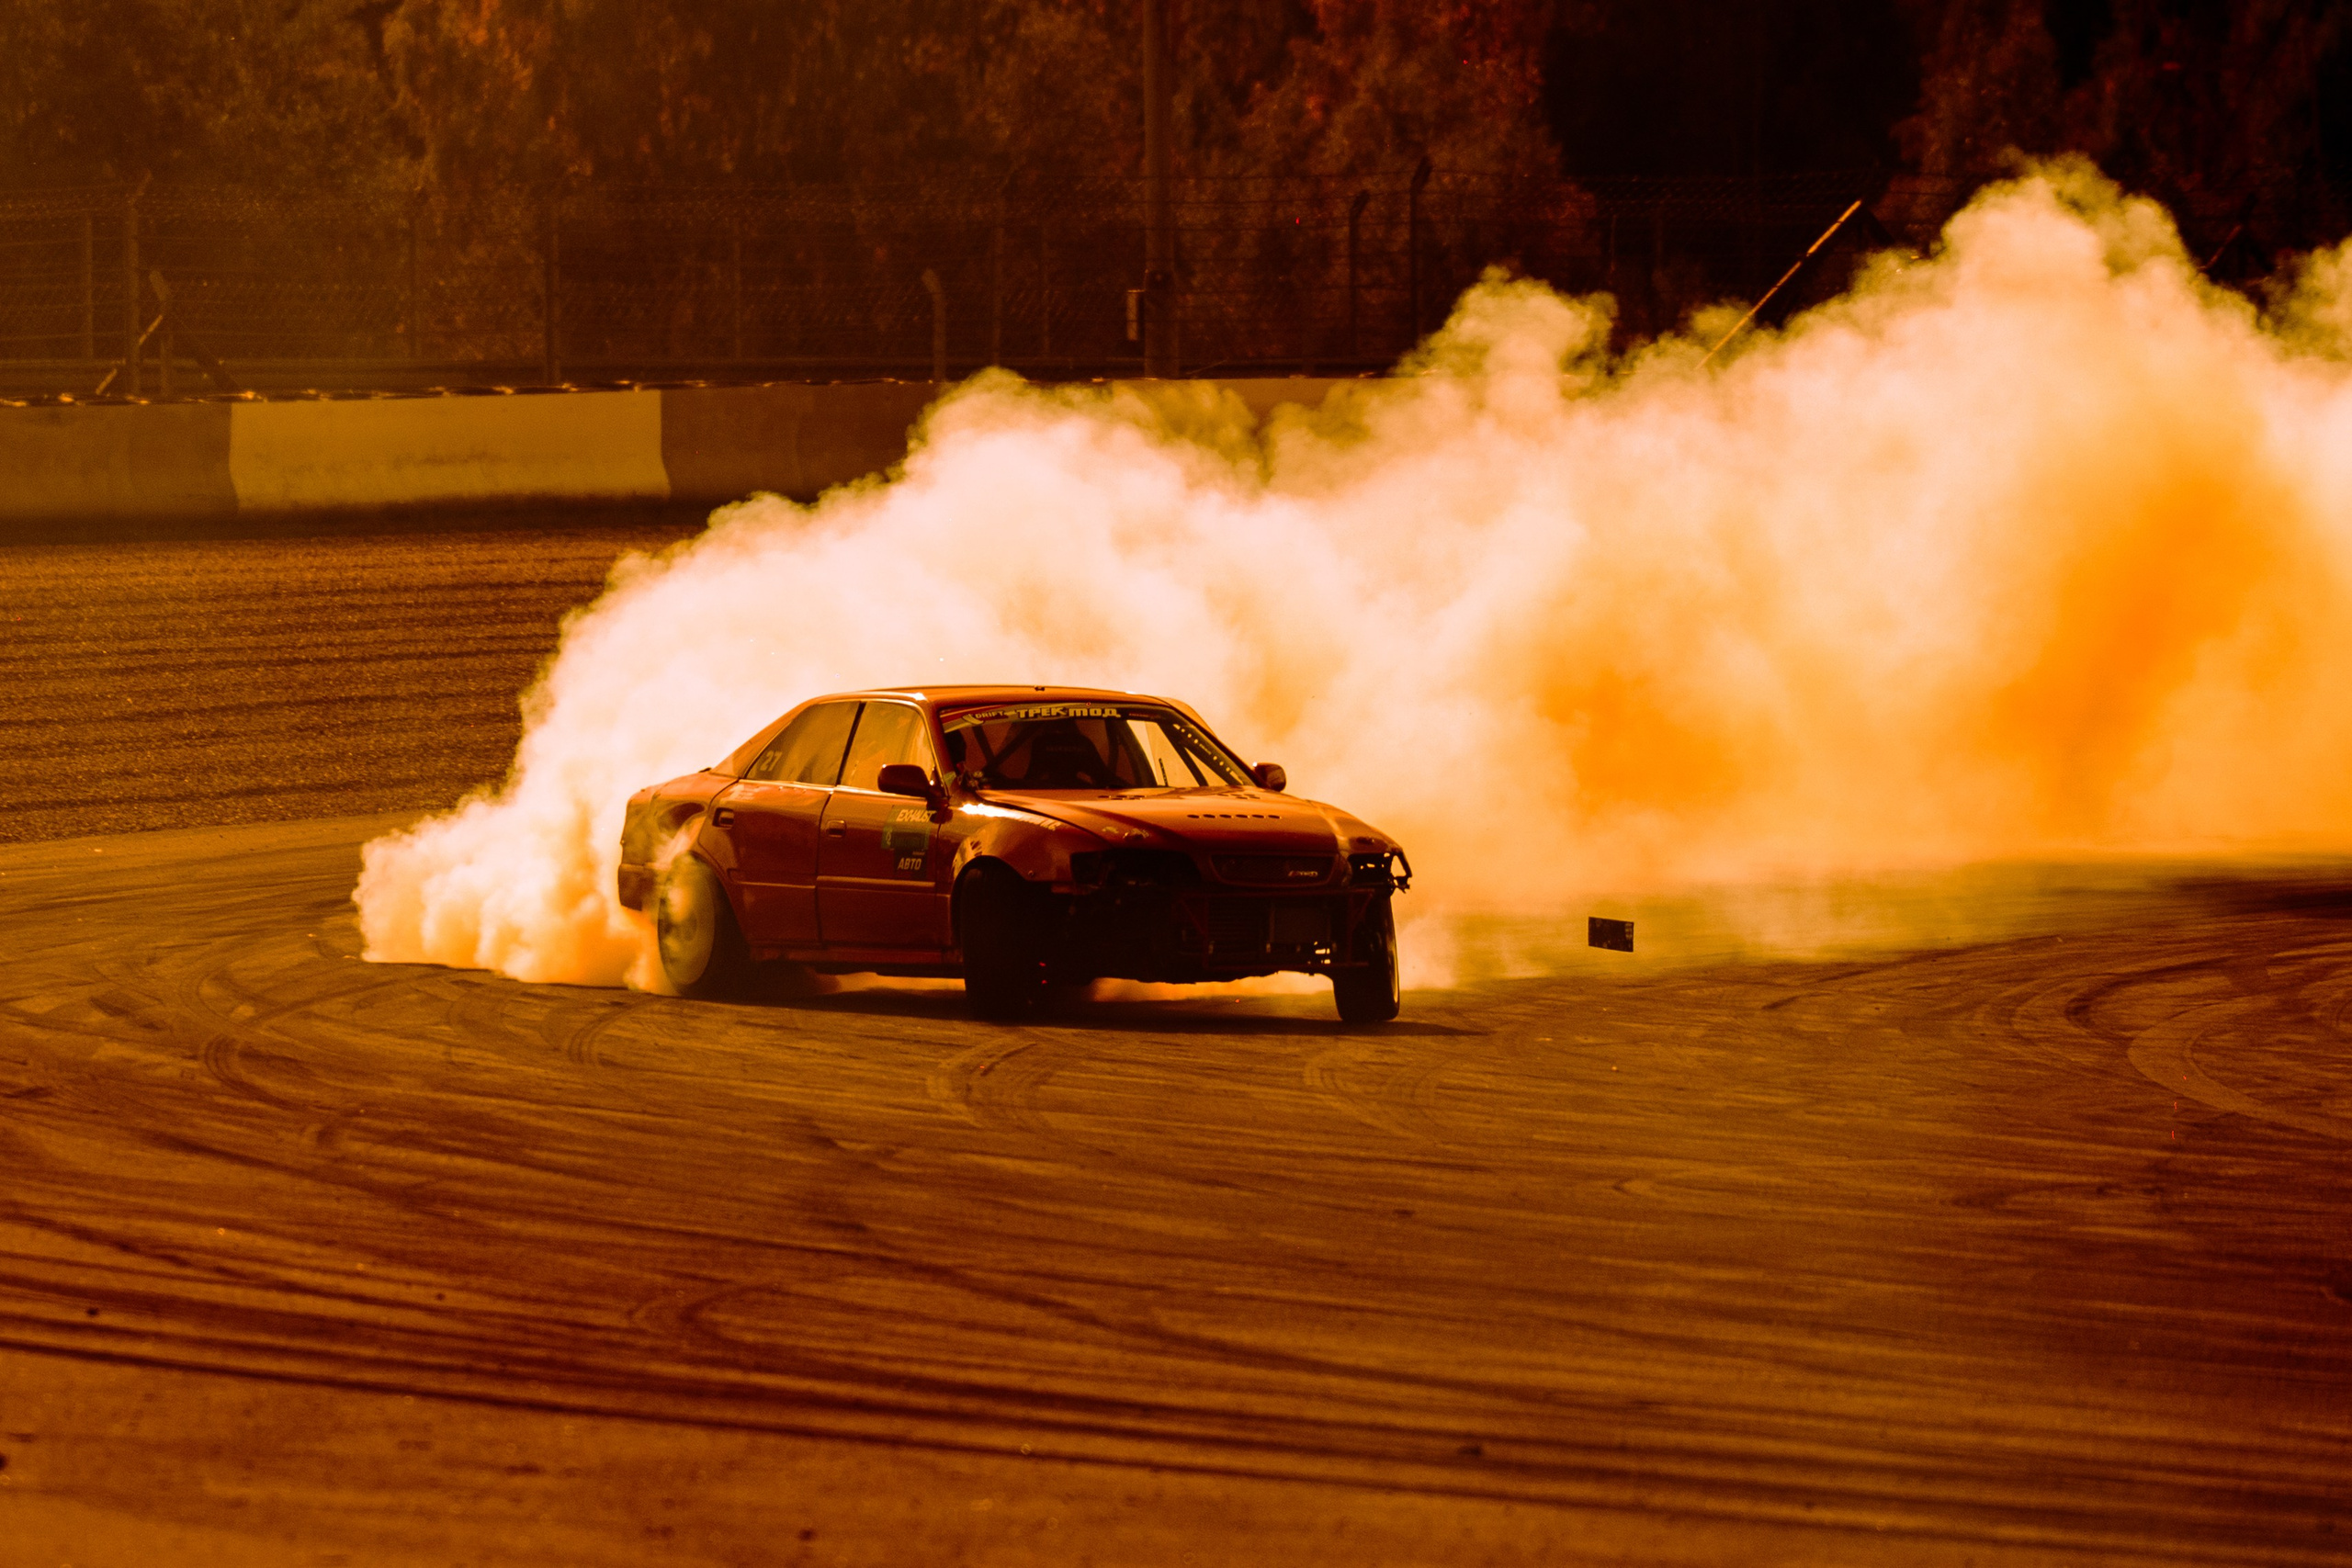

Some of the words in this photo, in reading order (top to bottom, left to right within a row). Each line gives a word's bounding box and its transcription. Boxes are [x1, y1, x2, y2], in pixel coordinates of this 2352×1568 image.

[975, 710, 1004, 718] DRIFT
[760, 751, 782, 772] 27
[896, 809, 937, 822] EXHAUST
